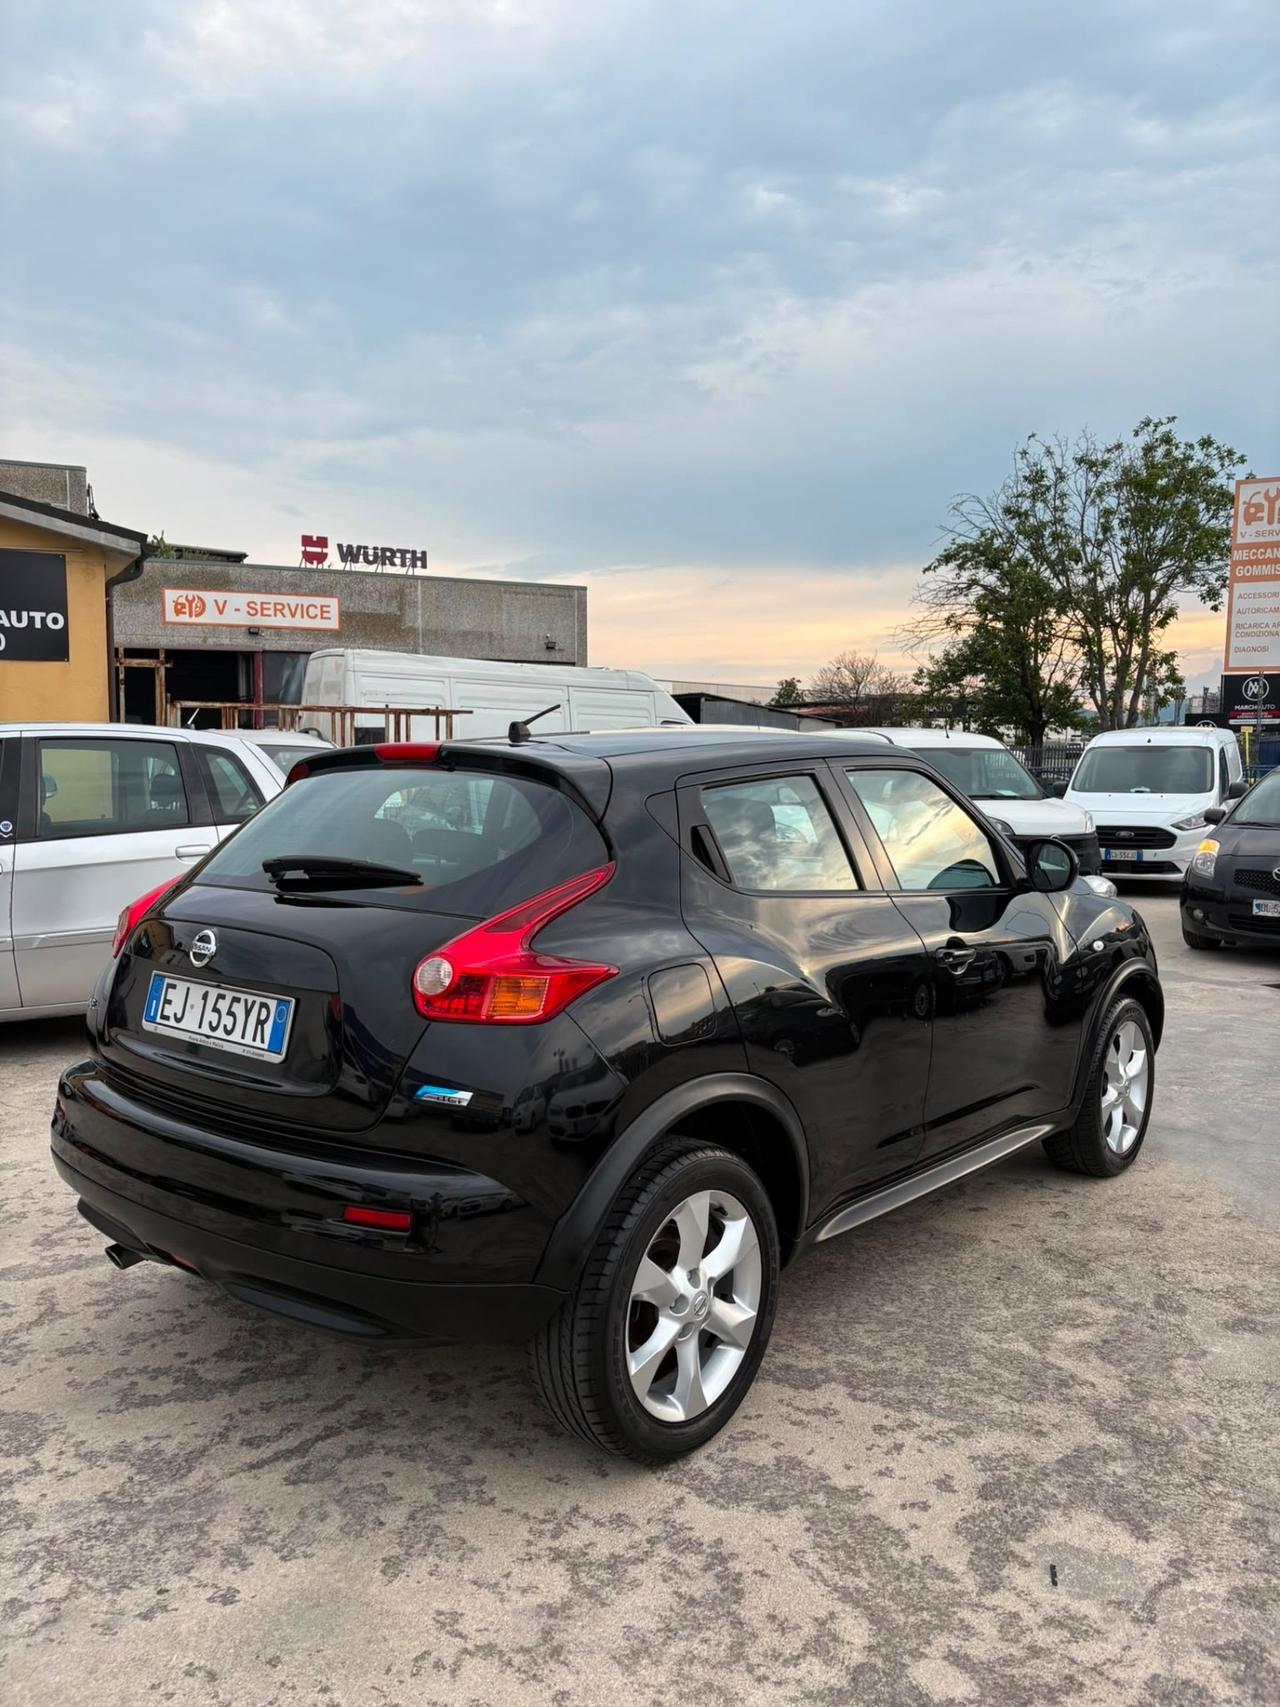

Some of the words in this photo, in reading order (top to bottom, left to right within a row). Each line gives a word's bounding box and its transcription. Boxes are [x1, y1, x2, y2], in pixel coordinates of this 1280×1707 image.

[336, 543, 427, 569] WÜRTH
[213, 599, 228, 615] V
[246, 600, 332, 620] SERVICE
[1233, 645, 1269, 653] DIAGNOSI
